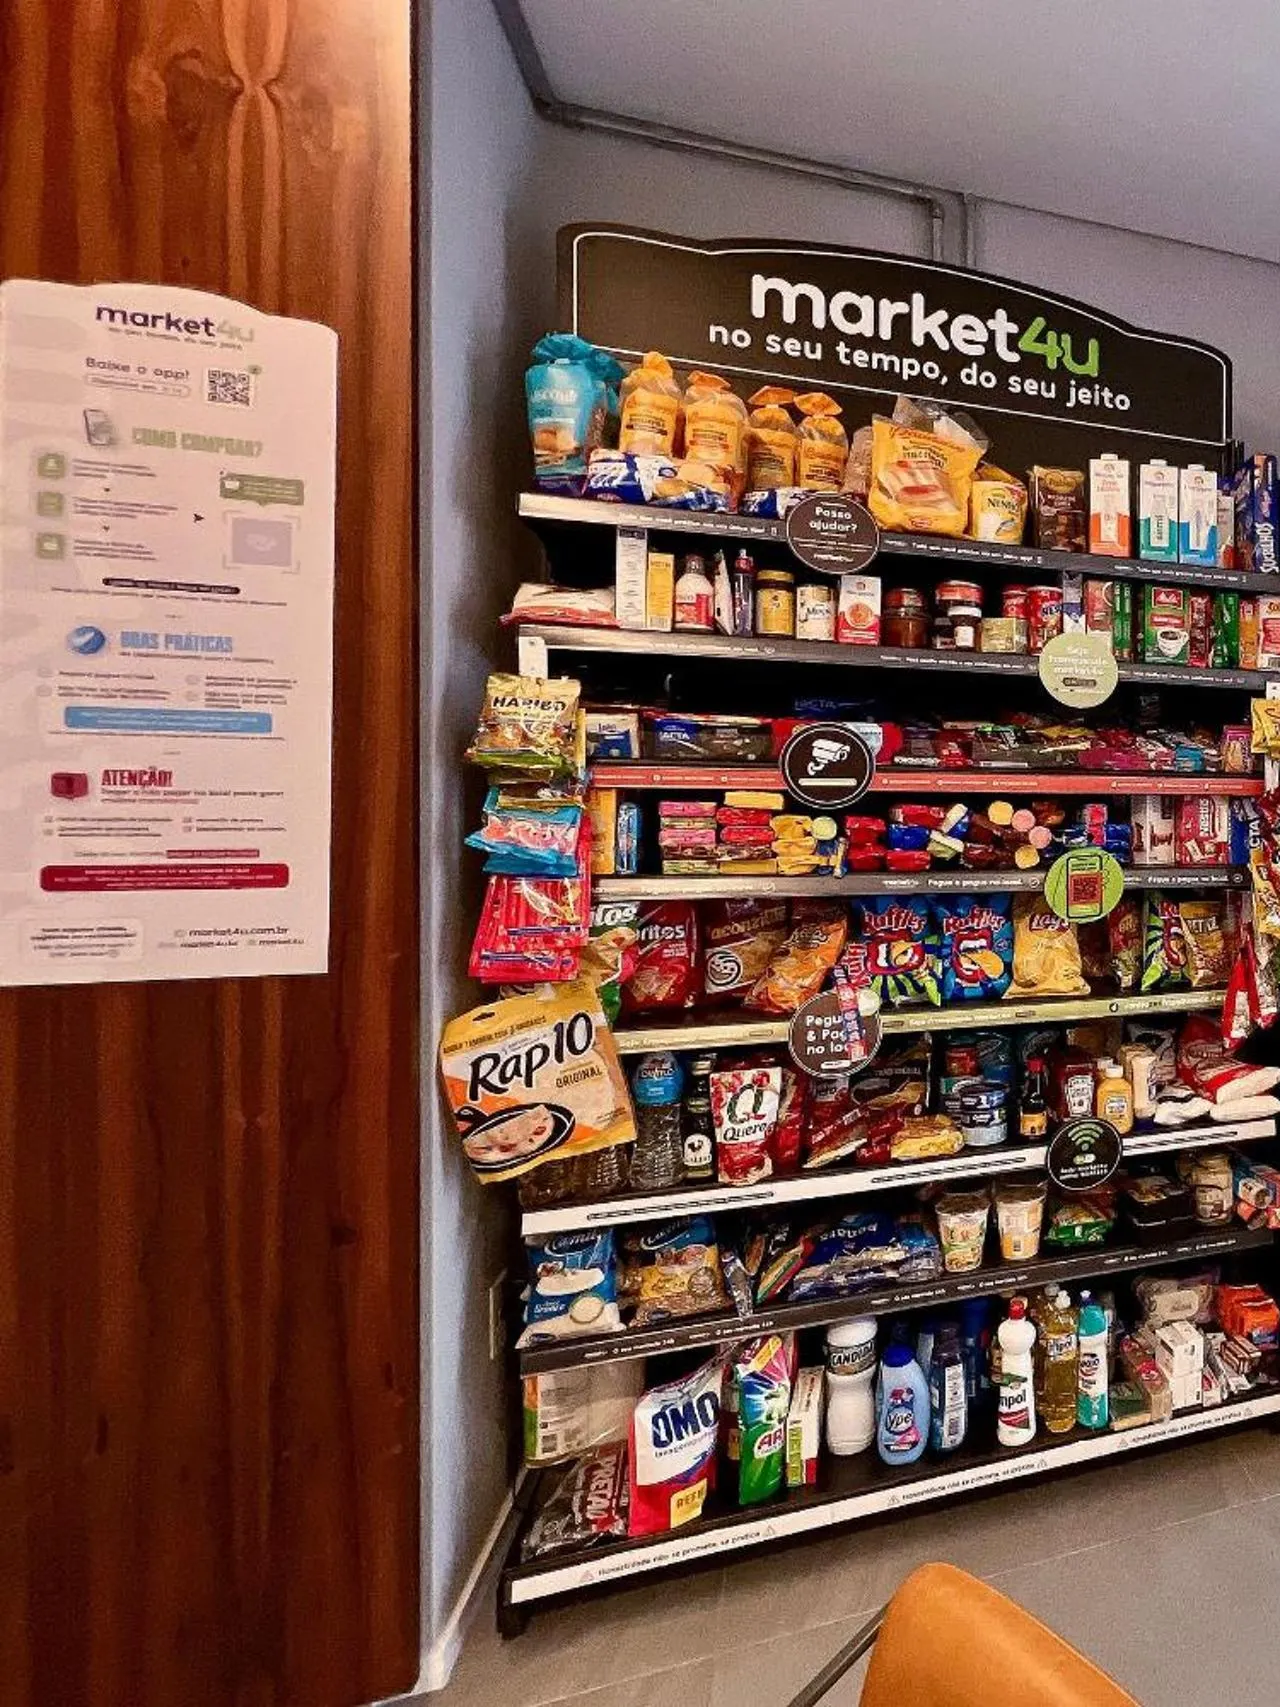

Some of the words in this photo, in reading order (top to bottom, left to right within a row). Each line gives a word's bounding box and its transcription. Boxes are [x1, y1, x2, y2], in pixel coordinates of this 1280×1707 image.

[95, 305, 255, 342] market4u
[750, 272, 1100, 378] market4u
[708, 320, 752, 348] no
[764, 334, 823, 361] seu
[836, 341, 948, 386] tempo,
[960, 362, 998, 389] do
[1007, 375, 1056, 399] seu
[1065, 378, 1131, 411] jeito
[101, 766, 173, 788] ATENÇÃO!
[1248, 819, 1261, 848] CTA
[805, 1014, 843, 1028] Pegu
[806, 1029, 817, 1042] &
[469, 1011, 594, 1102] Rap10
[806, 1044, 826, 1056] no
[556, 1065, 603, 1088] ORIGINAL
[652, 1392, 719, 1448] OMO
